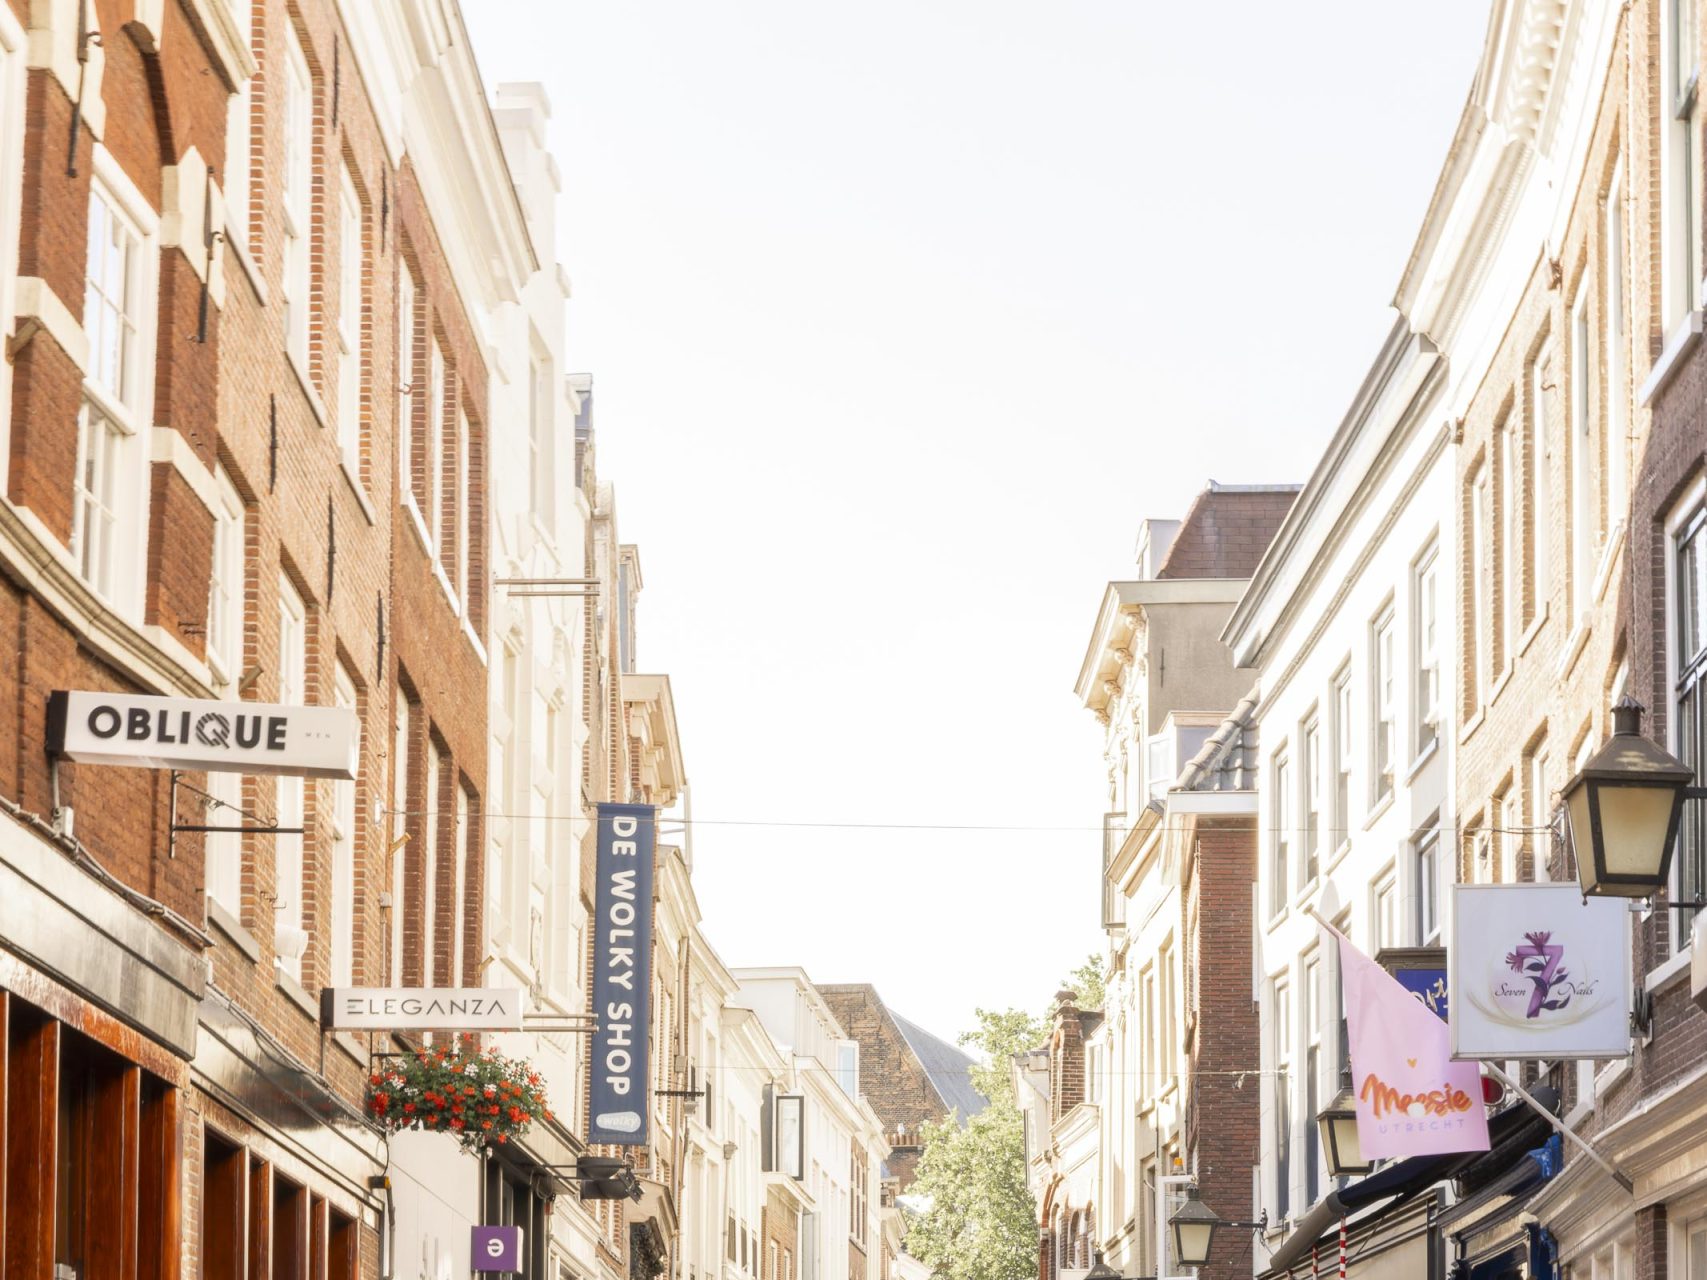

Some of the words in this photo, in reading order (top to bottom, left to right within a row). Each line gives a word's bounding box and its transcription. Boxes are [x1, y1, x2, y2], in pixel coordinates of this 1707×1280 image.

[88, 705, 288, 750] OBLIQUE
[612, 815, 638, 856] DE
[608, 870, 636, 991] WOLKY
[347, 998, 506, 1015] ELEGANZA
[1494, 982, 1527, 998] Seven
[1557, 979, 1599, 997] Nails
[606, 1002, 633, 1095] SHOP
[1379, 1118, 1466, 1135] UTRECHT
